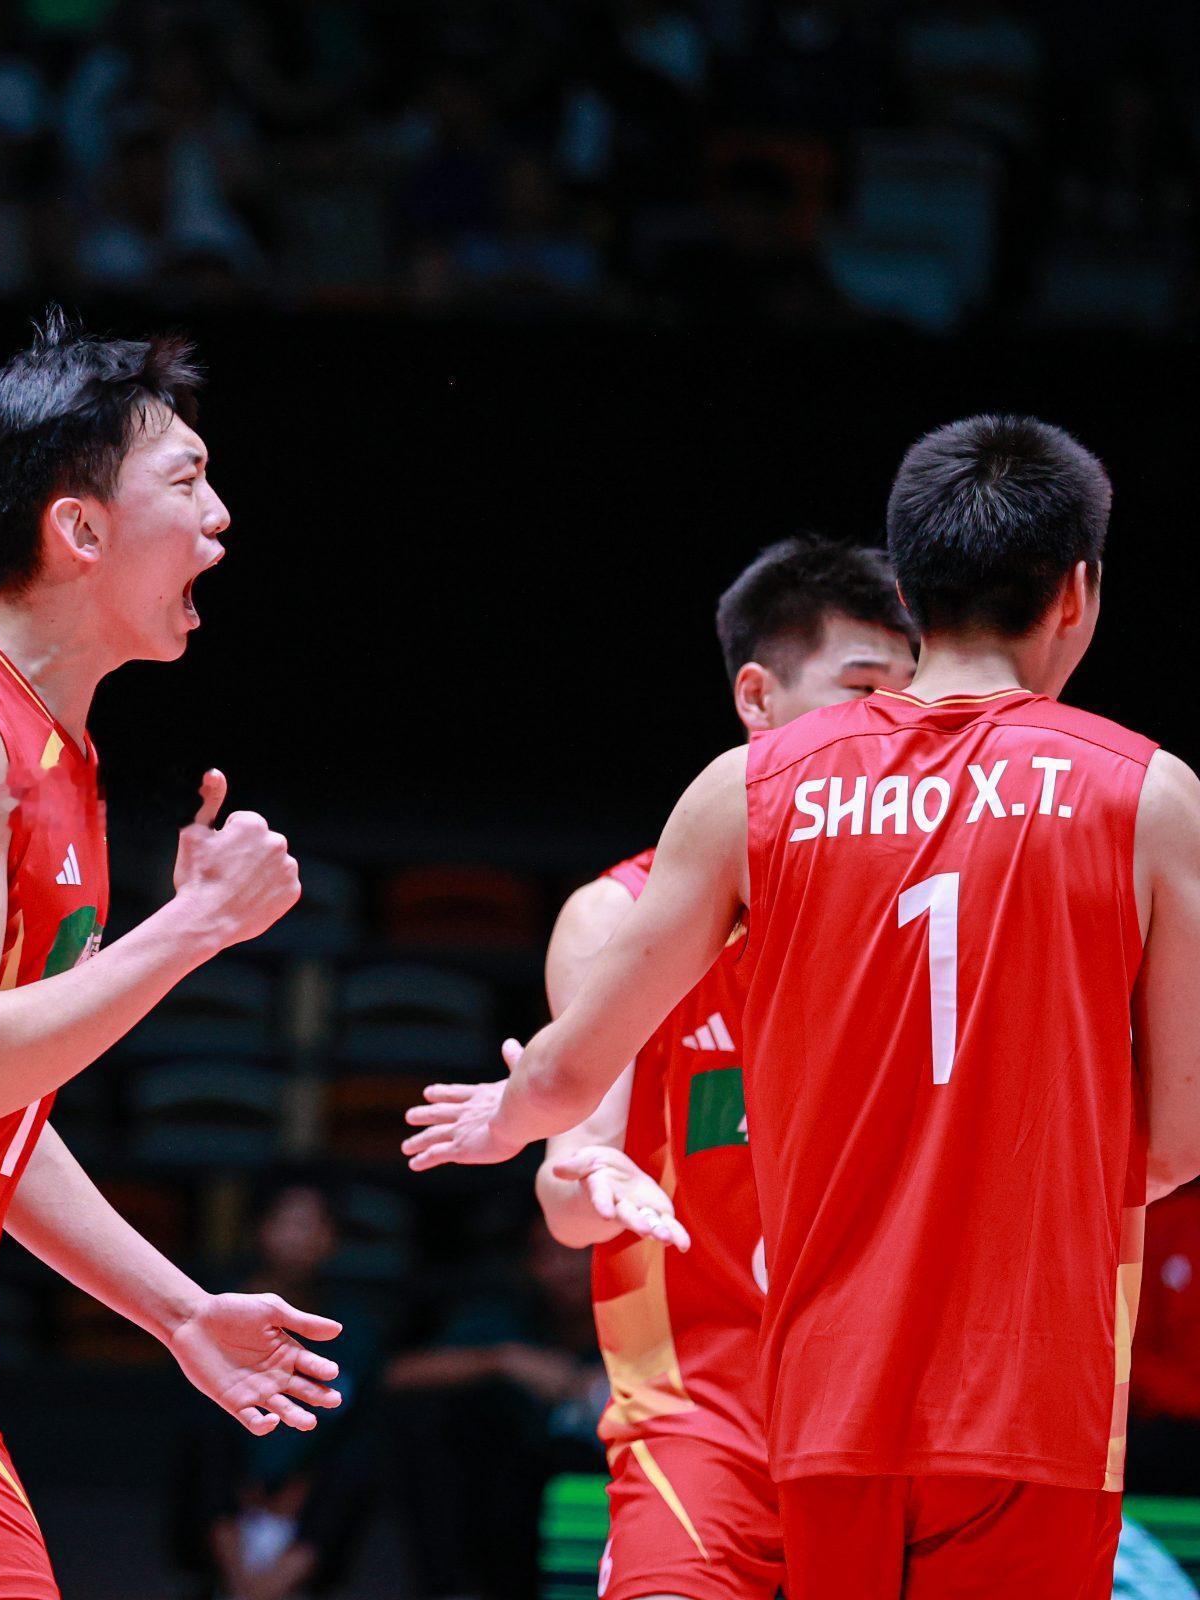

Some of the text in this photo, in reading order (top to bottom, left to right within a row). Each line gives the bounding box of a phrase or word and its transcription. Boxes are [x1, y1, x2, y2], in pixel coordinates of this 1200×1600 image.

[789, 756, 1072, 843] SHAO X.T.
[898, 872, 960, 1085] 1
